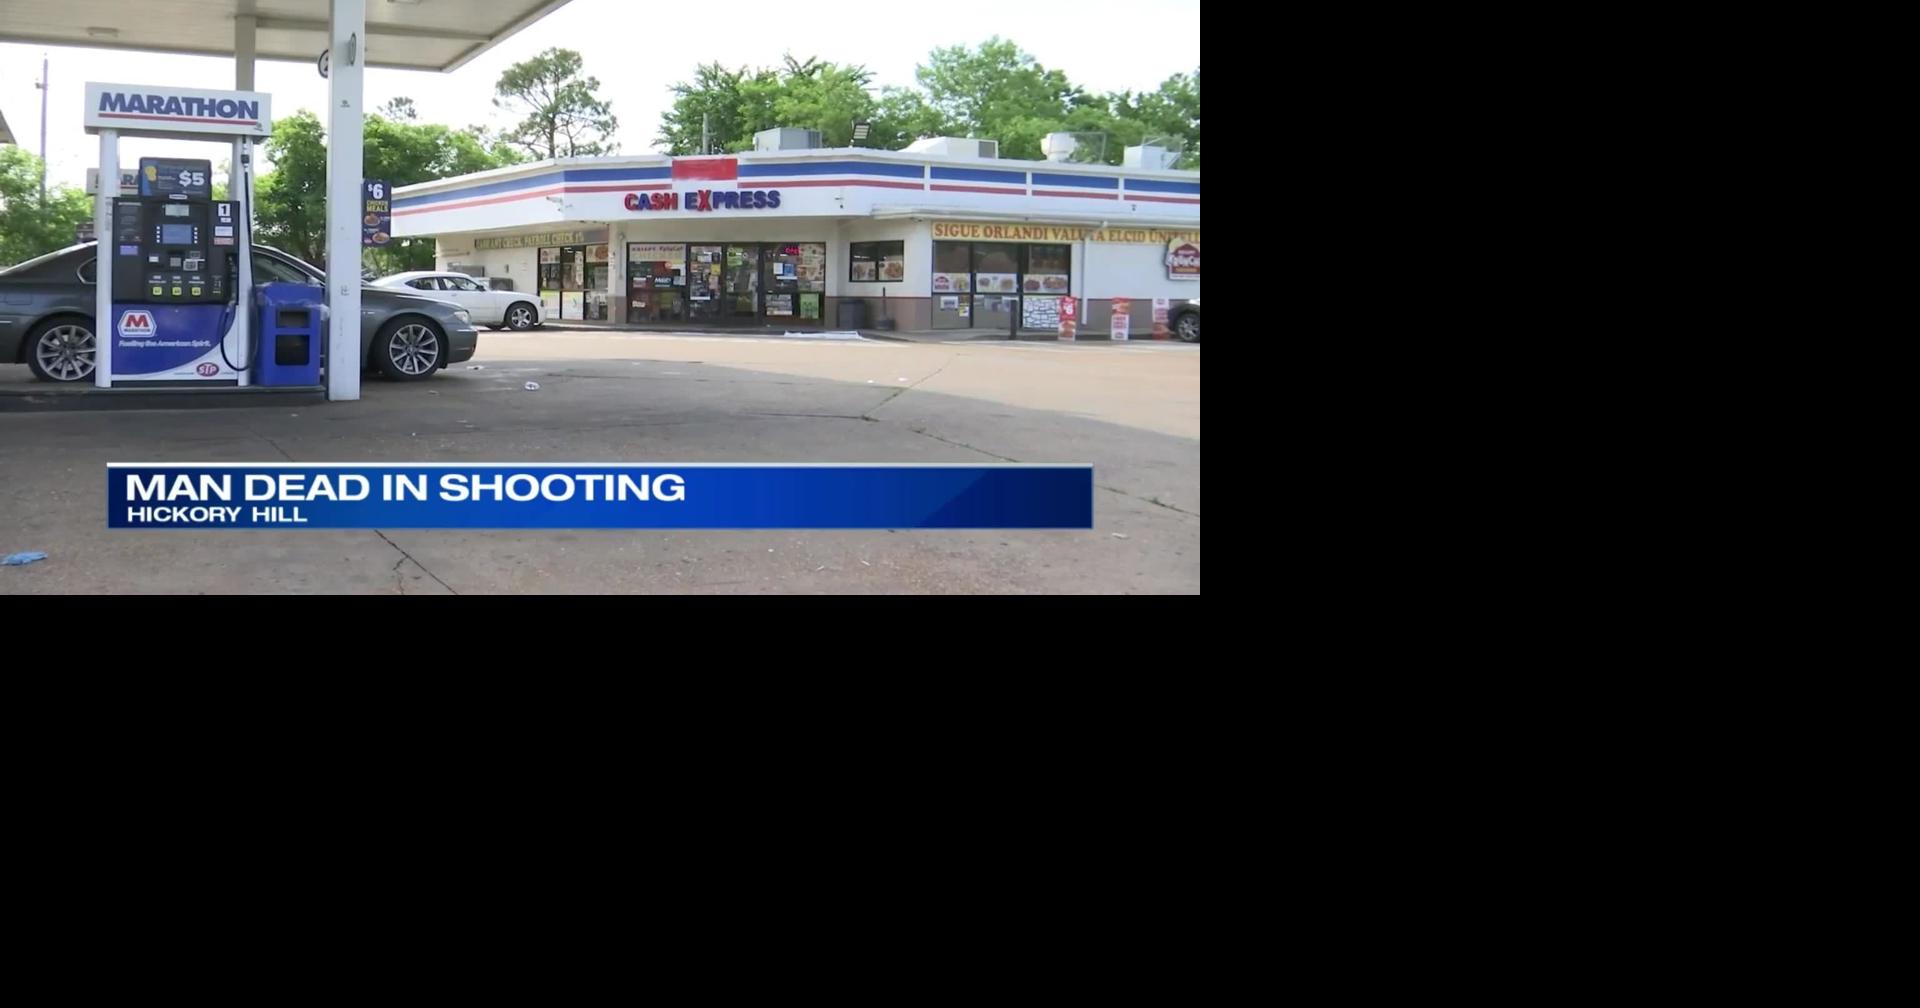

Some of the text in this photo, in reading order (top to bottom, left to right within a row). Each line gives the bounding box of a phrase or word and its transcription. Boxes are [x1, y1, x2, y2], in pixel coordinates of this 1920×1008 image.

[100, 92, 258, 119] MARATHON
[179, 170, 205, 187] $5
[367, 183, 384, 200] $6
[624, 190, 781, 211] CASH EXPRESS
[220, 205, 228, 215] 1
[934, 223, 980, 238] SIGUE
[983, 225, 1048, 240] ORLANDI
[125, 315, 149, 327] M
[198, 363, 217, 376] STP
